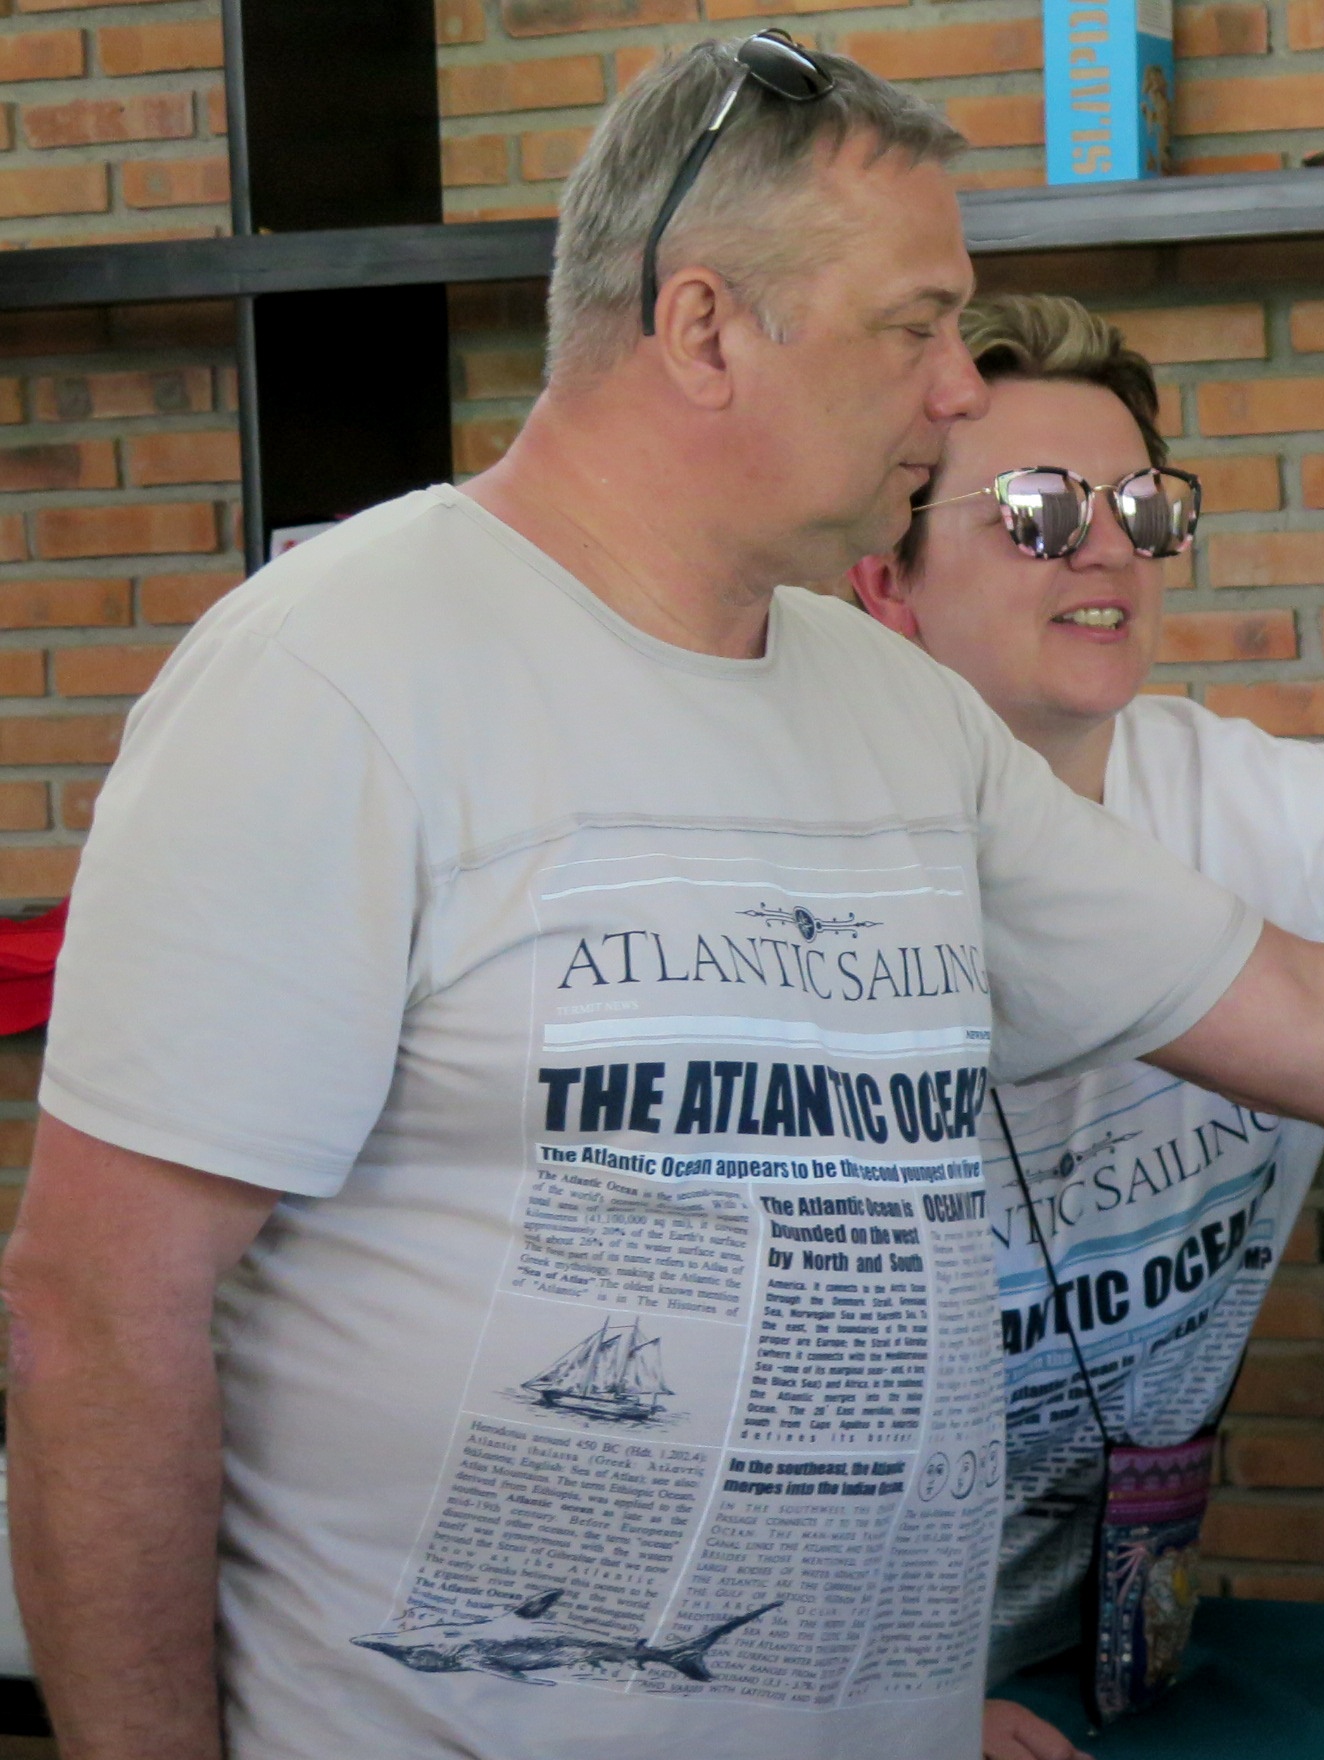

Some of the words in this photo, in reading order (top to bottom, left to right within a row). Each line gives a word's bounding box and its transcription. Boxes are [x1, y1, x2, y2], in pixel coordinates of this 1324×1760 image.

[1065, 0, 1110, 177] SLAPD
[557, 931, 832, 1000] ATLANTIC
[838, 943, 990, 1001] SAILING
[604, 1000, 639, 1012] NEWS
[538, 1062, 665, 1134] THE
[675, 1060, 889, 1145] ATLANTIC
[541, 1146, 577, 1162] The
[581, 1147, 657, 1175] Atlantic
[661, 1156, 712, 1177] Ocean
[716, 1159, 789, 1179] appears
[791, 1160, 808, 1179] to
[812, 1159, 837, 1179] be
[860, 1164, 899, 1183] second
[899, 1163, 945, 1184] youngest
[606, 1180, 638, 1196] Ocean
[760, 1196, 794, 1216] The
[798, 1195, 866, 1216] Atlantic
[866, 1197, 903, 1217] Ocean
[902, 1199, 914, 1217] is
[991, 1181, 1085, 1249] NTIC
[770, 1219, 848, 1243] bounded
[851, 1227, 867, 1245] on
[870, 1225, 890, 1245] the
[891, 1227, 920, 1245] west
[768, 1247, 793, 1270] by
[803, 1250, 849, 1272] North
[856, 1253, 883, 1273] and
[889, 1253, 924, 1273] South
[1001, 1270, 1130, 1355] ANTIC
[602, 1442, 620, 1453] BC
[730, 1457, 746, 1472] In
[748, 1459, 773, 1475] the
[723, 1478, 783, 1496] merges
[785, 1480, 815, 1495] into
[817, 1480, 839, 1495] the
